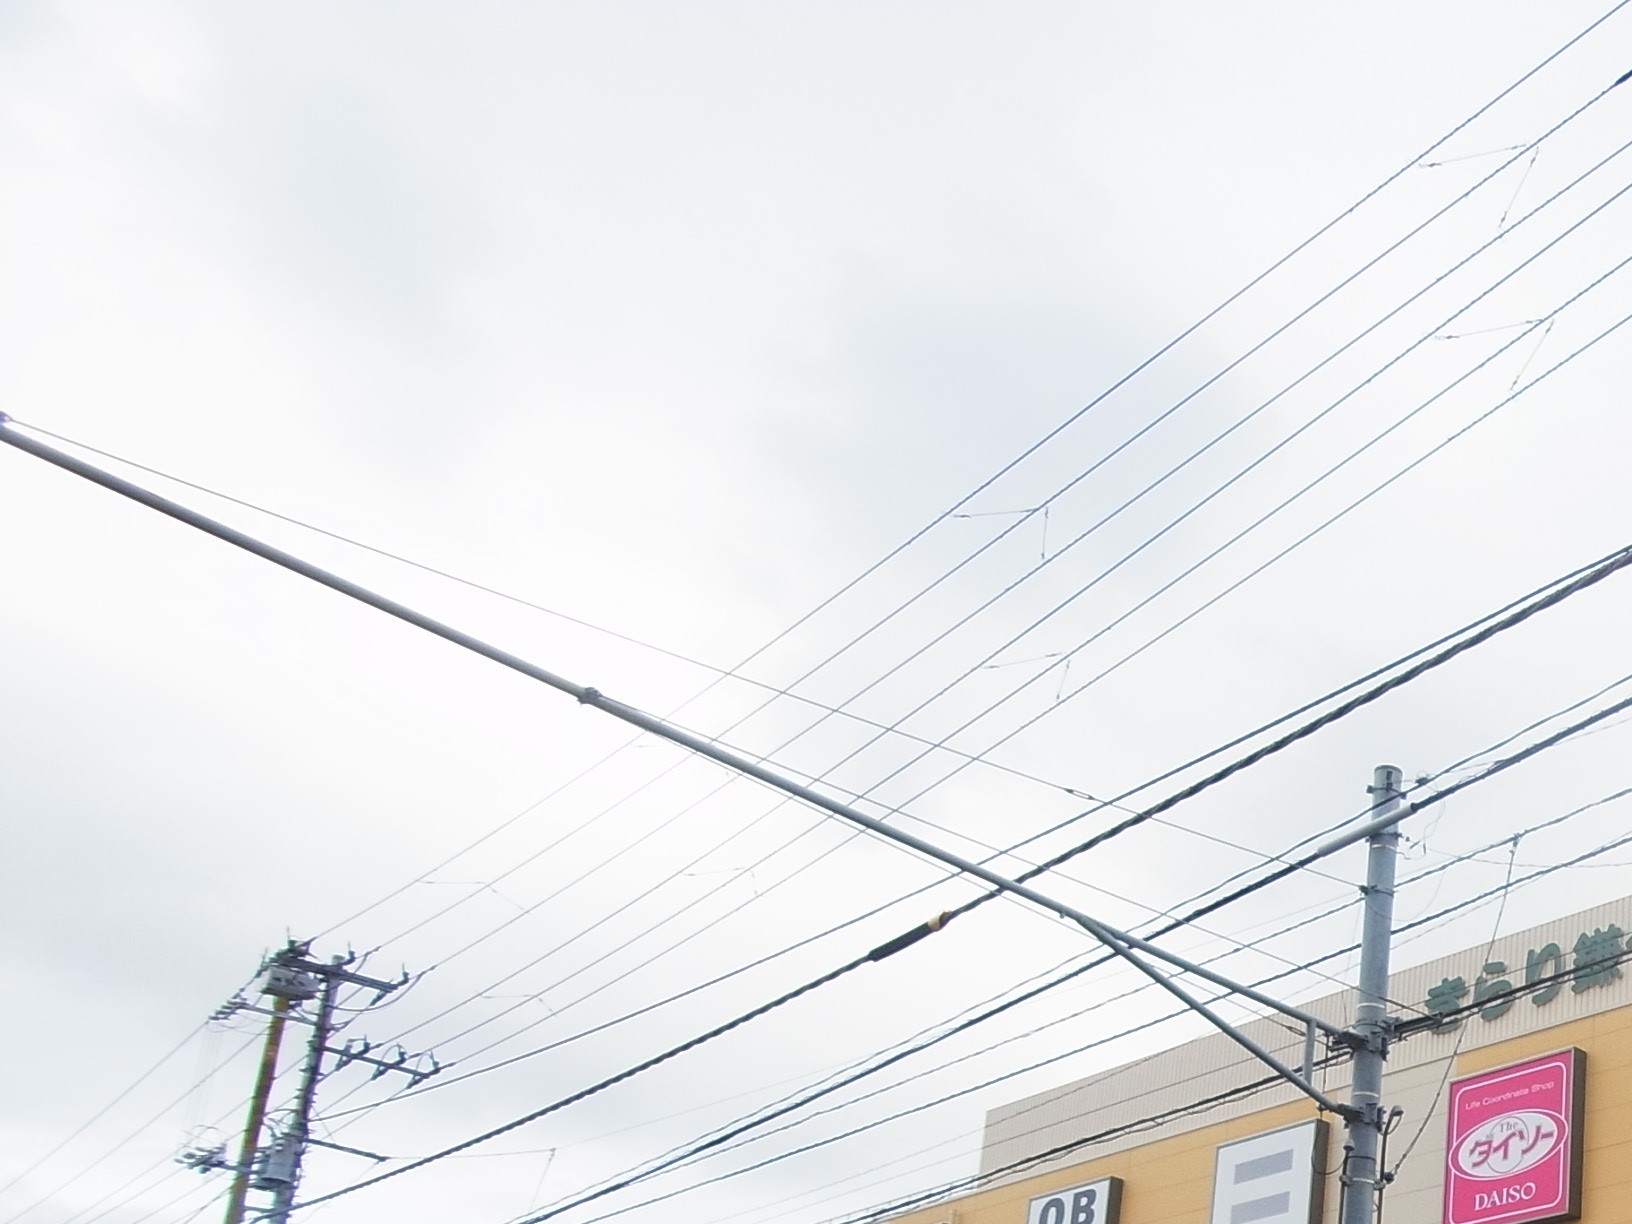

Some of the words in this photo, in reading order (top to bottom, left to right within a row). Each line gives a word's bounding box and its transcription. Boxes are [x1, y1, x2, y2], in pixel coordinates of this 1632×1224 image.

[1465, 1100, 1481, 1111] Life
[1482, 1087, 1529, 1106] Coordinate
[1531, 1081, 1555, 1094] Shop
[1500, 1121, 1519, 1133] The
[1474, 1182, 1537, 1211] DAISO
